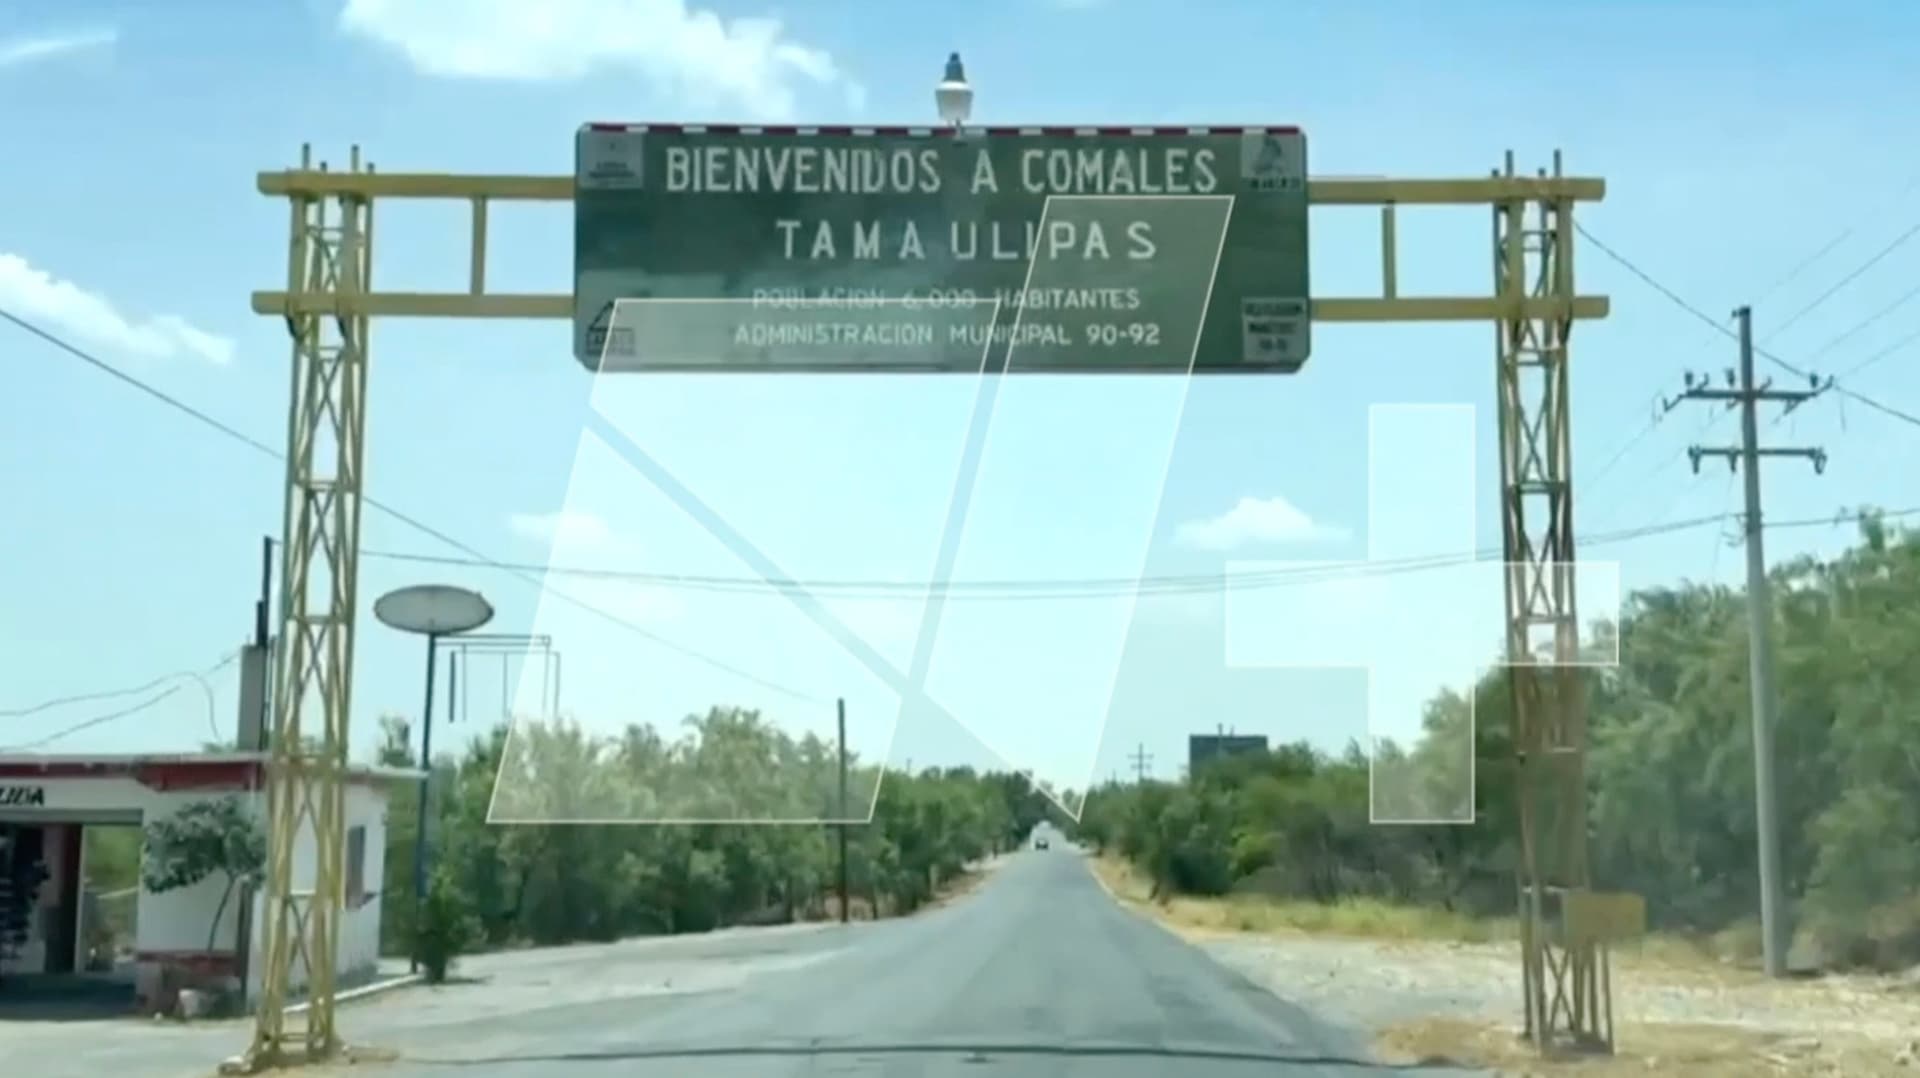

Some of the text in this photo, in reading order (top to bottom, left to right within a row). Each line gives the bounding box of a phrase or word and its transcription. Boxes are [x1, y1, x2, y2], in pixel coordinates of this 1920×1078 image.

[665, 146, 1217, 195] BIENVENIDOS A COMALES
[994, 287, 1141, 309] HABITANTES
[734, 322, 1160, 346] ADMINISTRACION MUNICIPAL 90-92
